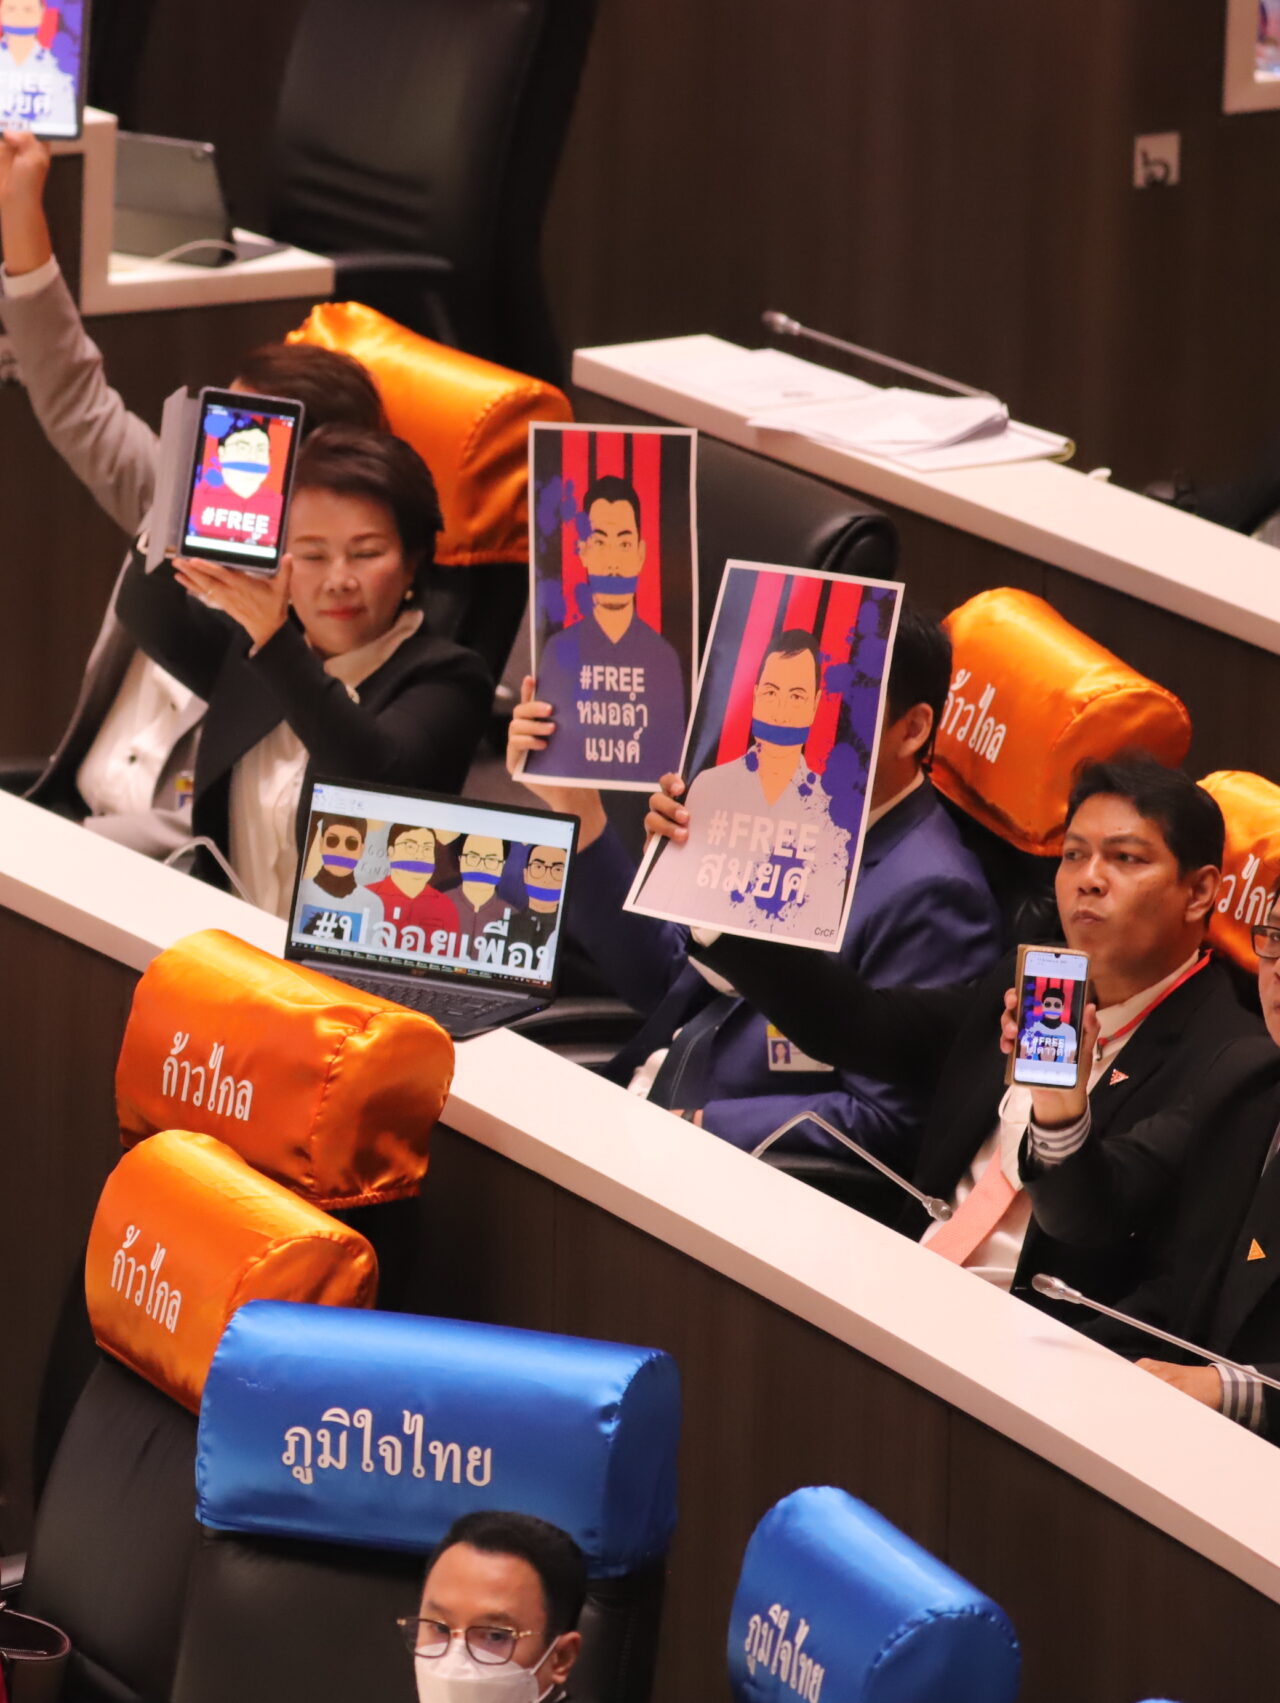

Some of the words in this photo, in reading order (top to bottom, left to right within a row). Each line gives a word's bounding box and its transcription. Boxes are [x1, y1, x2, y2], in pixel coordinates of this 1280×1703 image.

[201, 507, 270, 534] #FREE
[580, 665, 645, 693] #FREE
[576, 692, 648, 727] หมอลำ
[585, 727, 643, 764] แบงค์
[707, 809, 820, 861] #FREE
[696, 853, 812, 904] สมยศ
[814, 927, 835, 938] CrCF
[162, 1031, 254, 1121] ก้าวไกล
[111, 1224, 182, 1333] ก้าวไกล
[281, 1407, 493, 1487] ภูมิใจไทย
[744, 1603, 825, 1703] ภูมิใจไทย
